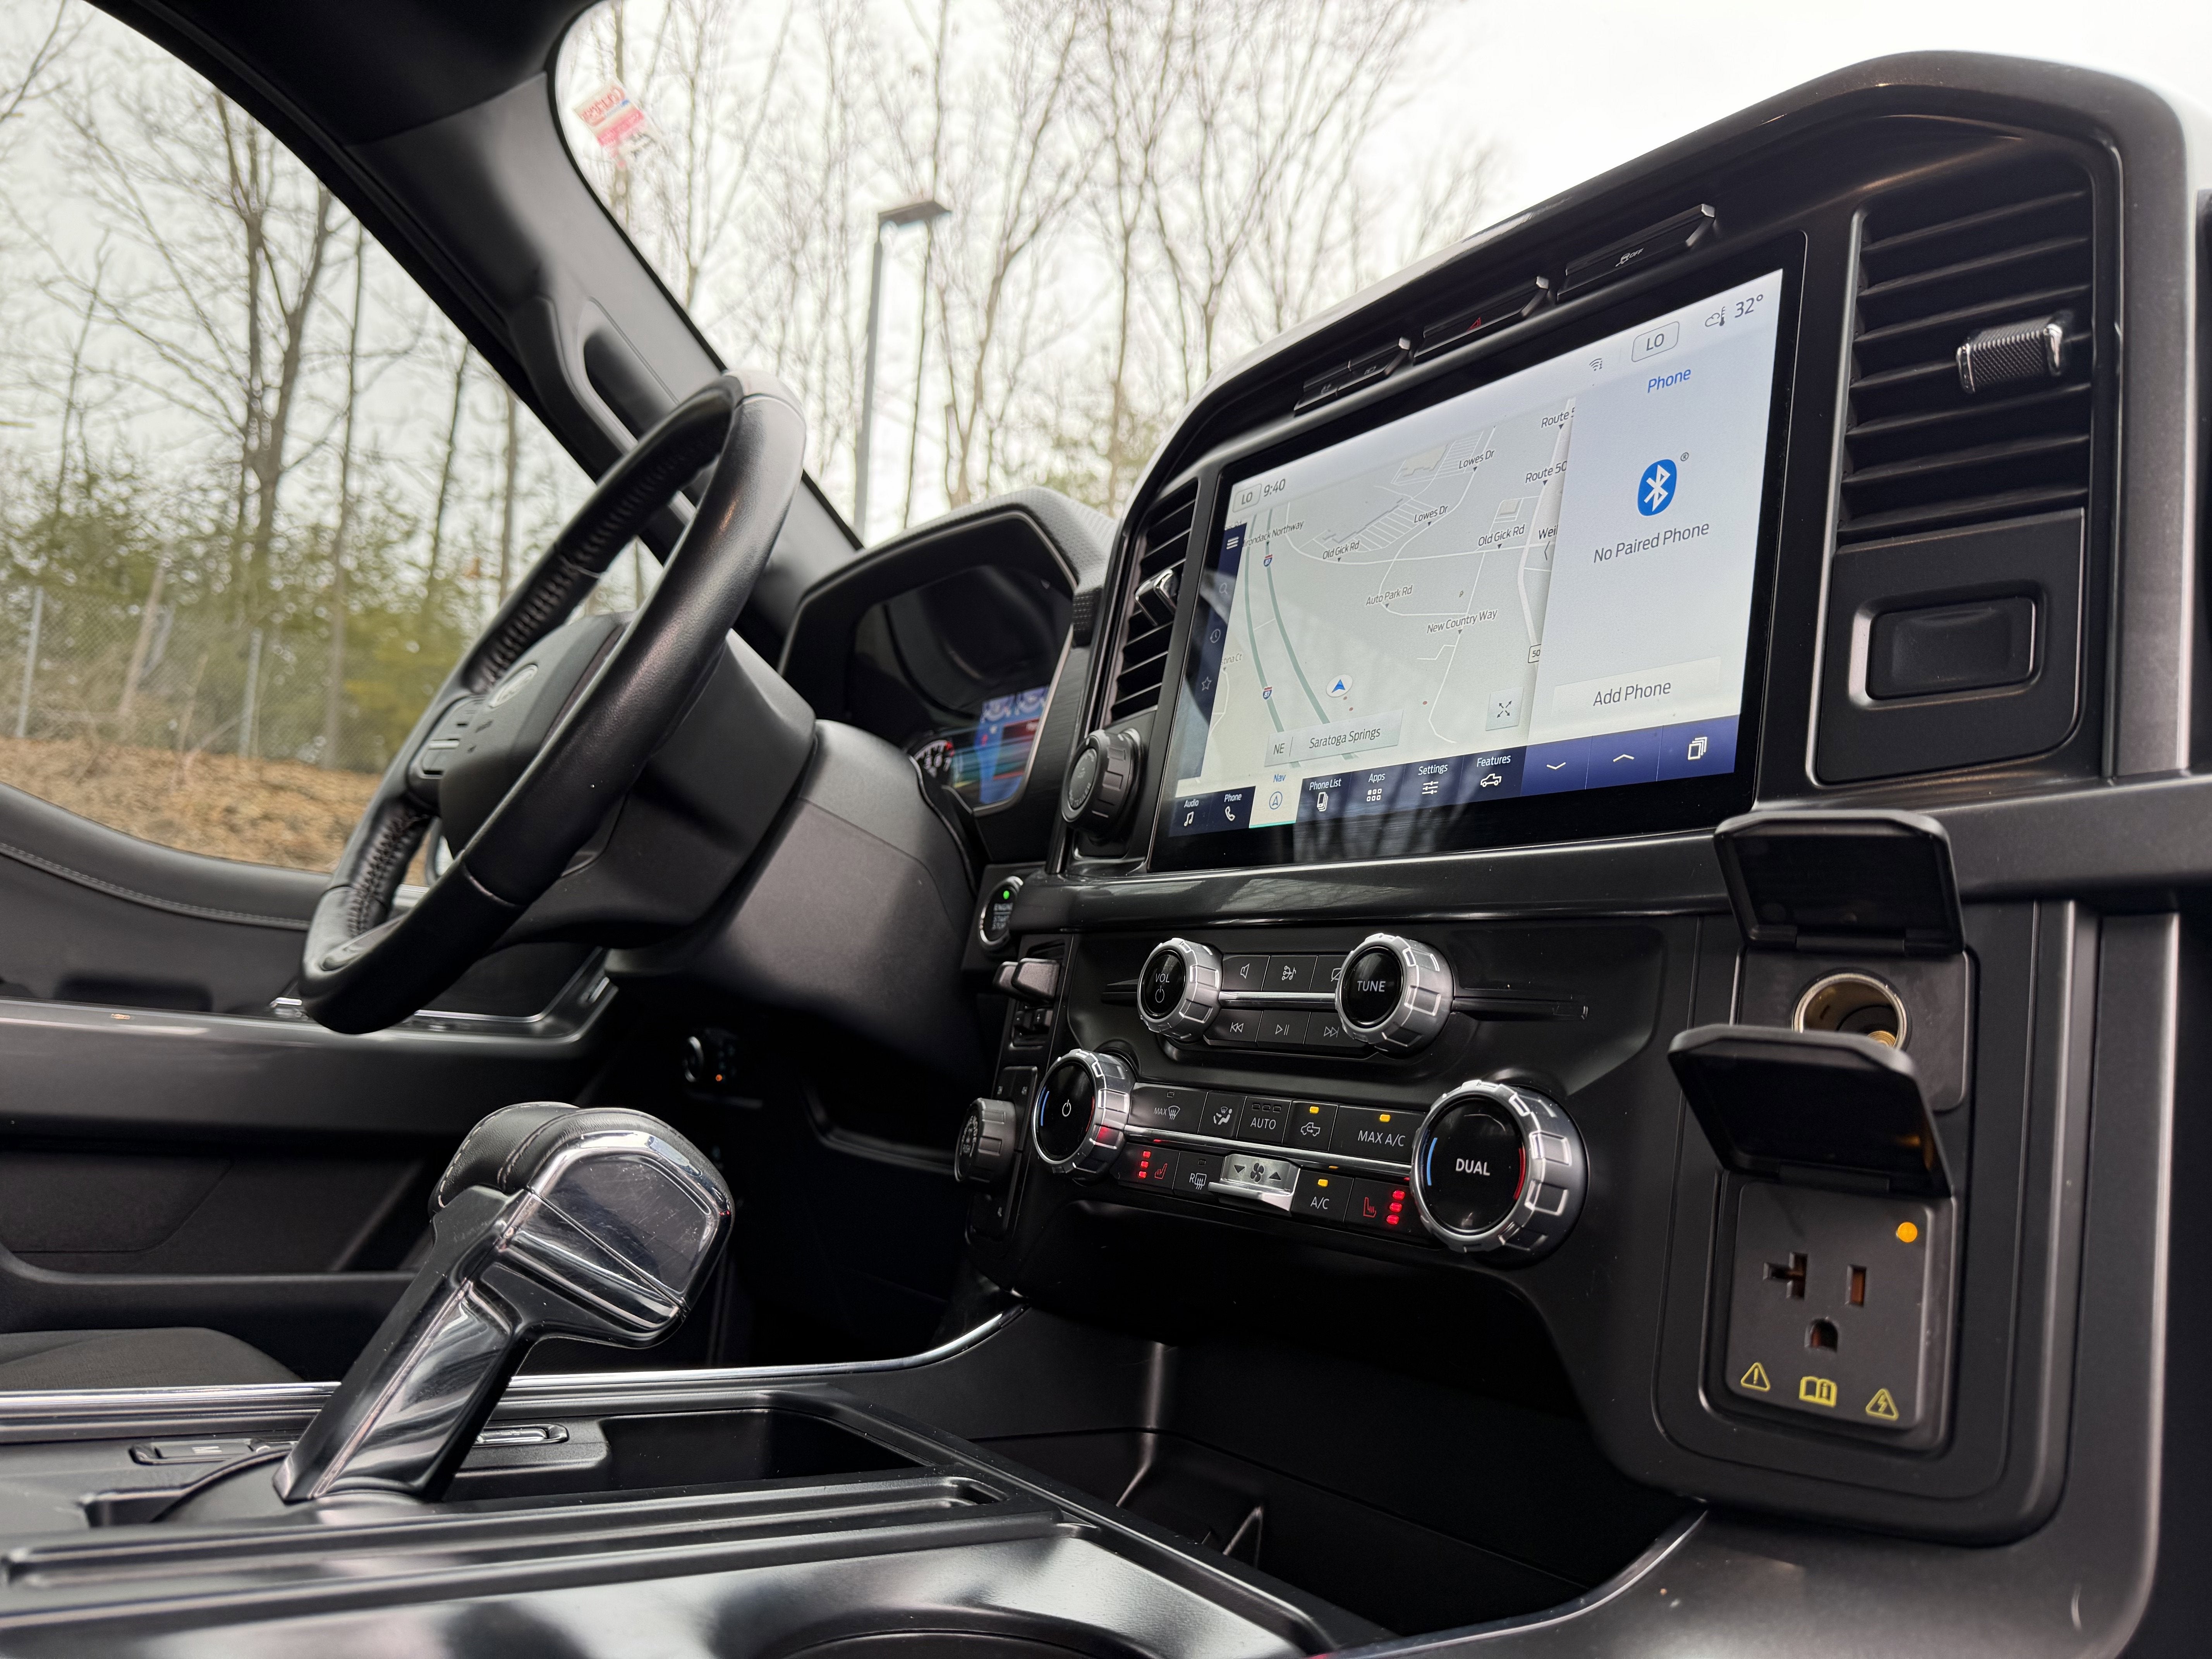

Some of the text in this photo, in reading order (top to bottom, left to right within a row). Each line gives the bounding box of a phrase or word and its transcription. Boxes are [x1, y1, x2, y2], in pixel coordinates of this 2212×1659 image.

[1646, 333, 1664, 351] LO
[1647, 368, 1691, 393] Phone
[1541, 411, 1569, 428] Route
[1459, 449, 1495, 469] Lowes Dr
[1525, 460, 1567, 483] Route 50
[1263, 479, 1286, 497] 9:40
[1241, 492, 1253, 504] LO
[1414, 505, 1448, 523] Lowes Dr
[1272, 521, 1304, 538] Northway
[1478, 524, 1525, 546] Old Gick Rd
[1322, 541, 1360, 560] Old Gick Rd
[1594, 523, 1709, 563] No Paired Phone
[1365, 585, 1413, 606] Auto Park Rd
[1427, 610, 1498, 634] New Country Way
[1235, 653, 1242, 661] Ct
[1532, 649, 1540, 658] 50
[1593, 682, 1671, 706] Add Phone
[1309, 727, 1381, 749] Saratoga Springs
[1273, 743, 1285, 755] NE
[1477, 755, 1511, 767] Features
[1273, 774, 1286, 783] Nav
[1368, 773, 1385, 783] Apps
[1418, 764, 1448, 776] Settings
[1309, 778, 1341, 790] Phone List
[1184, 799, 1199, 809] Audio
[1224, 793, 1242, 803] Phone
[1155, 973, 1170, 983] VOL
[1357, 980, 1385, 993] TUNE
[1154, 1106, 1167, 1116] MAX
[1250, 1117, 1276, 1130] AUTO
[1358, 1130, 1405, 1147] MAX A/C
[1456, 1158, 1491, 1176] DUAL
[1310, 1196, 1329, 1210] A/C
